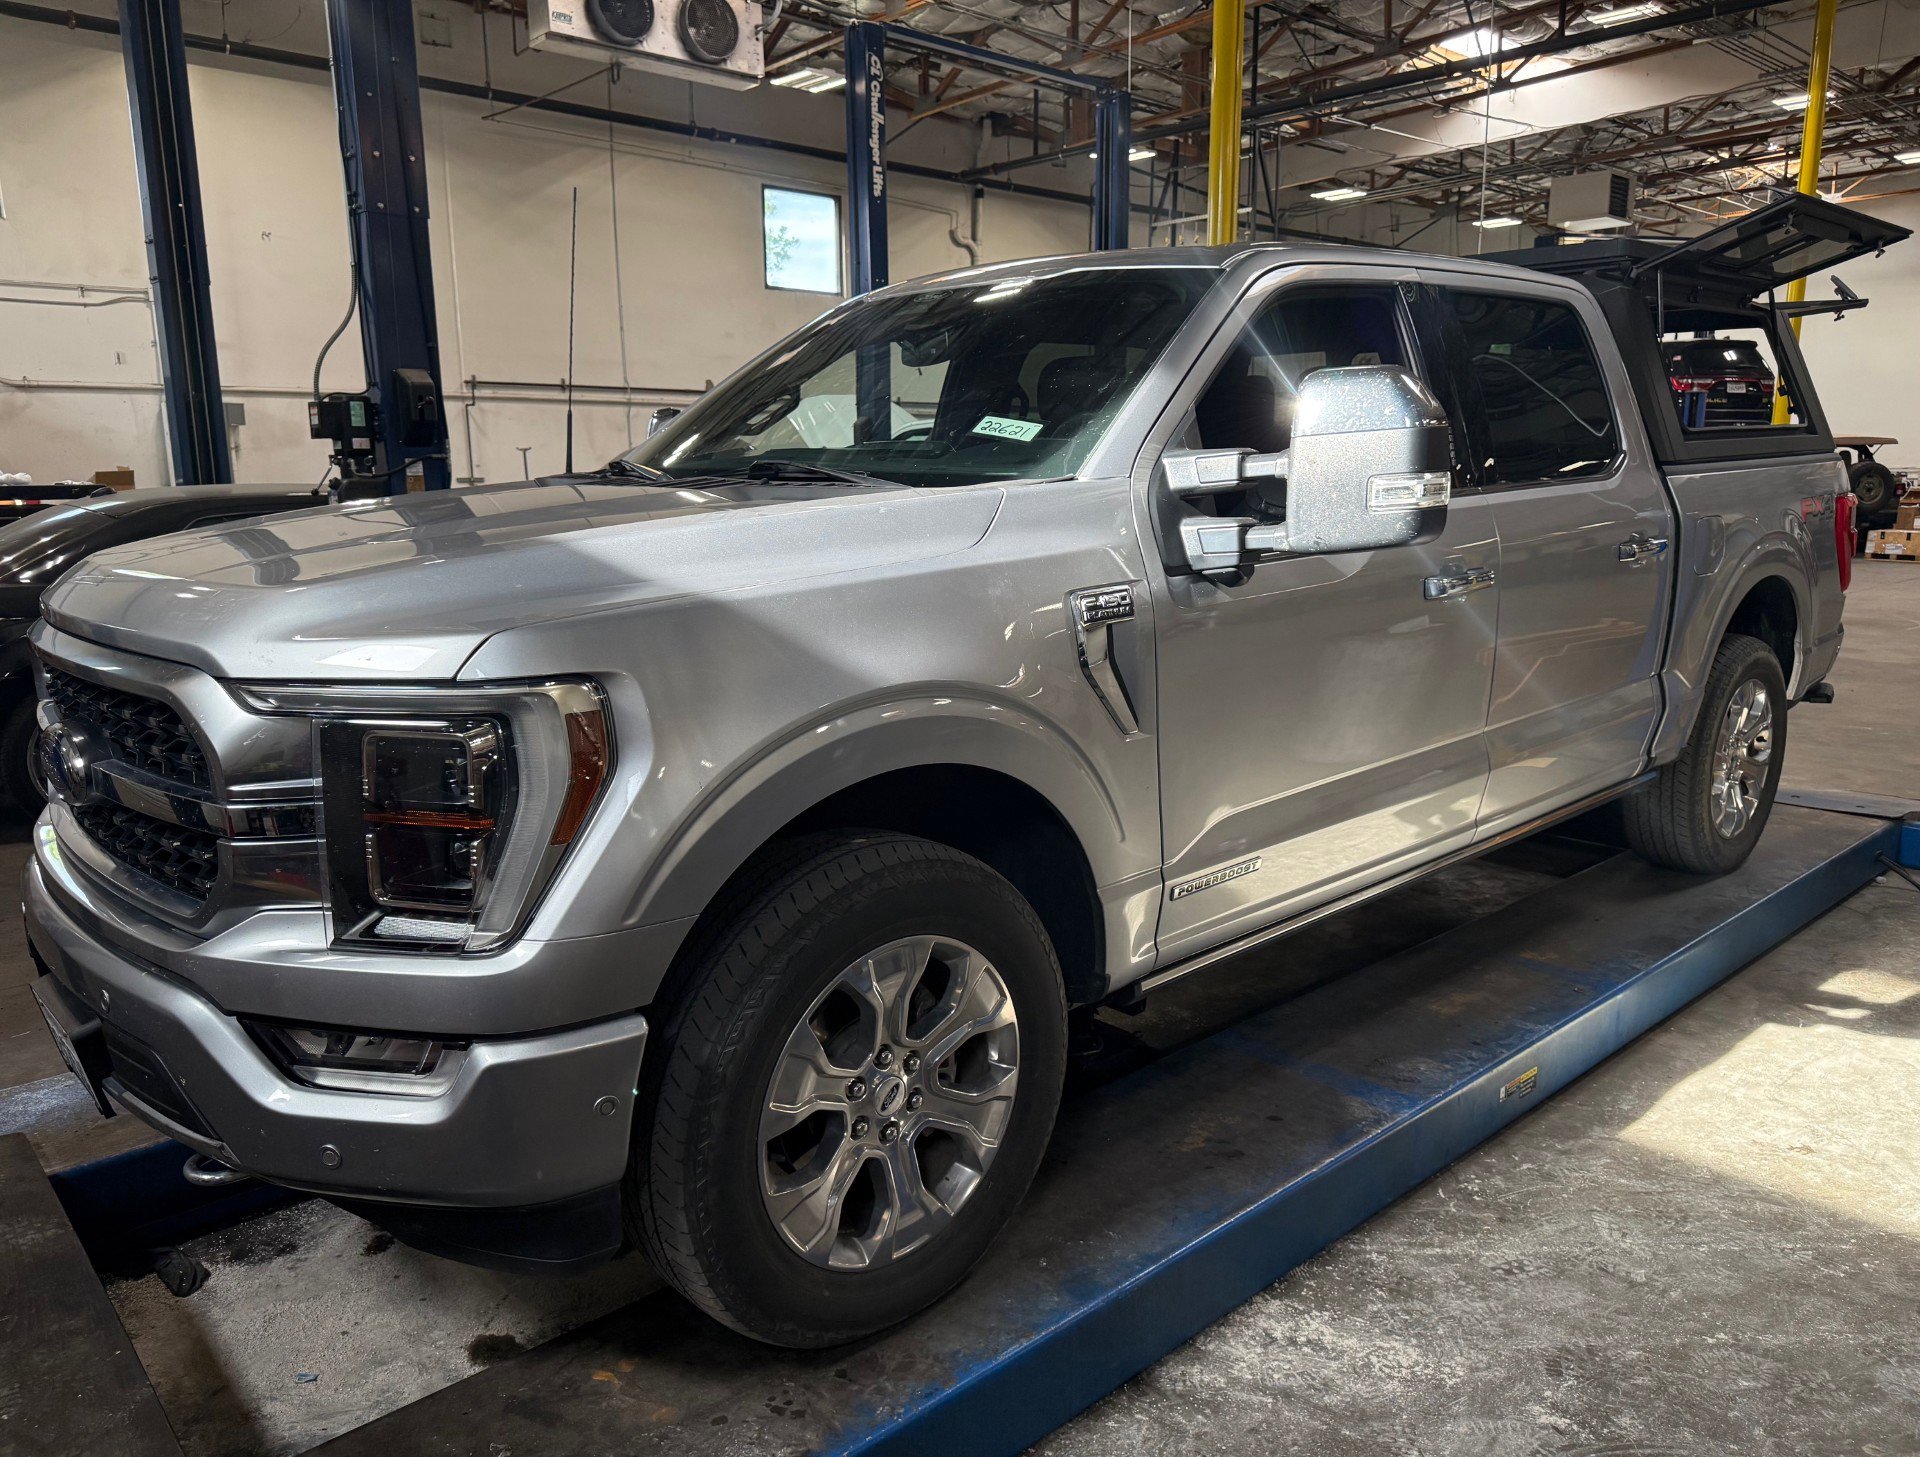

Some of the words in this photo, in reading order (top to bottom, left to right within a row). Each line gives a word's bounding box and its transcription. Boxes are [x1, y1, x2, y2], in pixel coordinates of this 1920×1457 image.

[869, 81, 885, 165] Challenger
[872, 166, 884, 197] Lifts
[980, 420, 1031, 438] 22621
[1177, 860, 1259, 897] POWERBOOST
